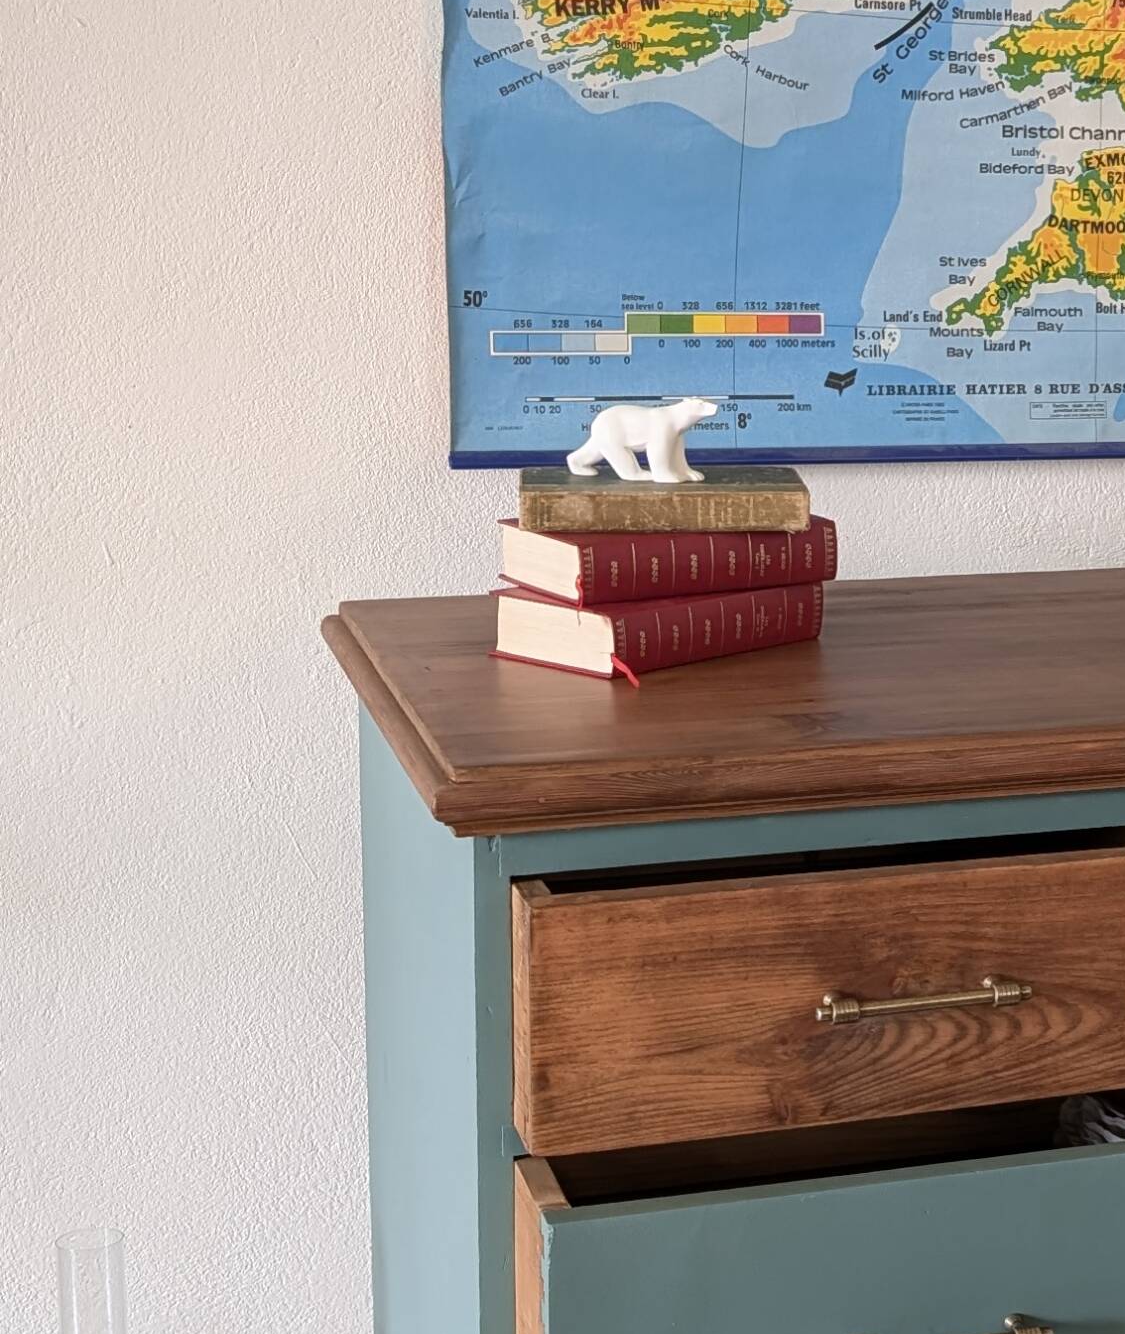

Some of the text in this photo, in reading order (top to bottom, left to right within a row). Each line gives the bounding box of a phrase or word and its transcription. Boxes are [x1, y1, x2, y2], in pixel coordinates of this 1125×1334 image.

[1002, 124, 1064, 140] Bristol
[1011, 148, 1041, 159] Lundy
[987, 249, 1065, 307] CORNWALL
[682, 301, 821, 310] 328 656 1312 3281 feet
[883, 311, 943, 323] Land's End
[1014, 306, 1083, 318] Falmouth
[1037, 321, 1064, 333] Bay
[684, 339, 836, 348] 100 200 400 1000 meters
[866, 384, 957, 397] LIBRAIRIE
[966, 384, 1027, 396] HATIER
[1034, 384, 1043, 395] 8
[1049, 383, 1081, 395] RUE
